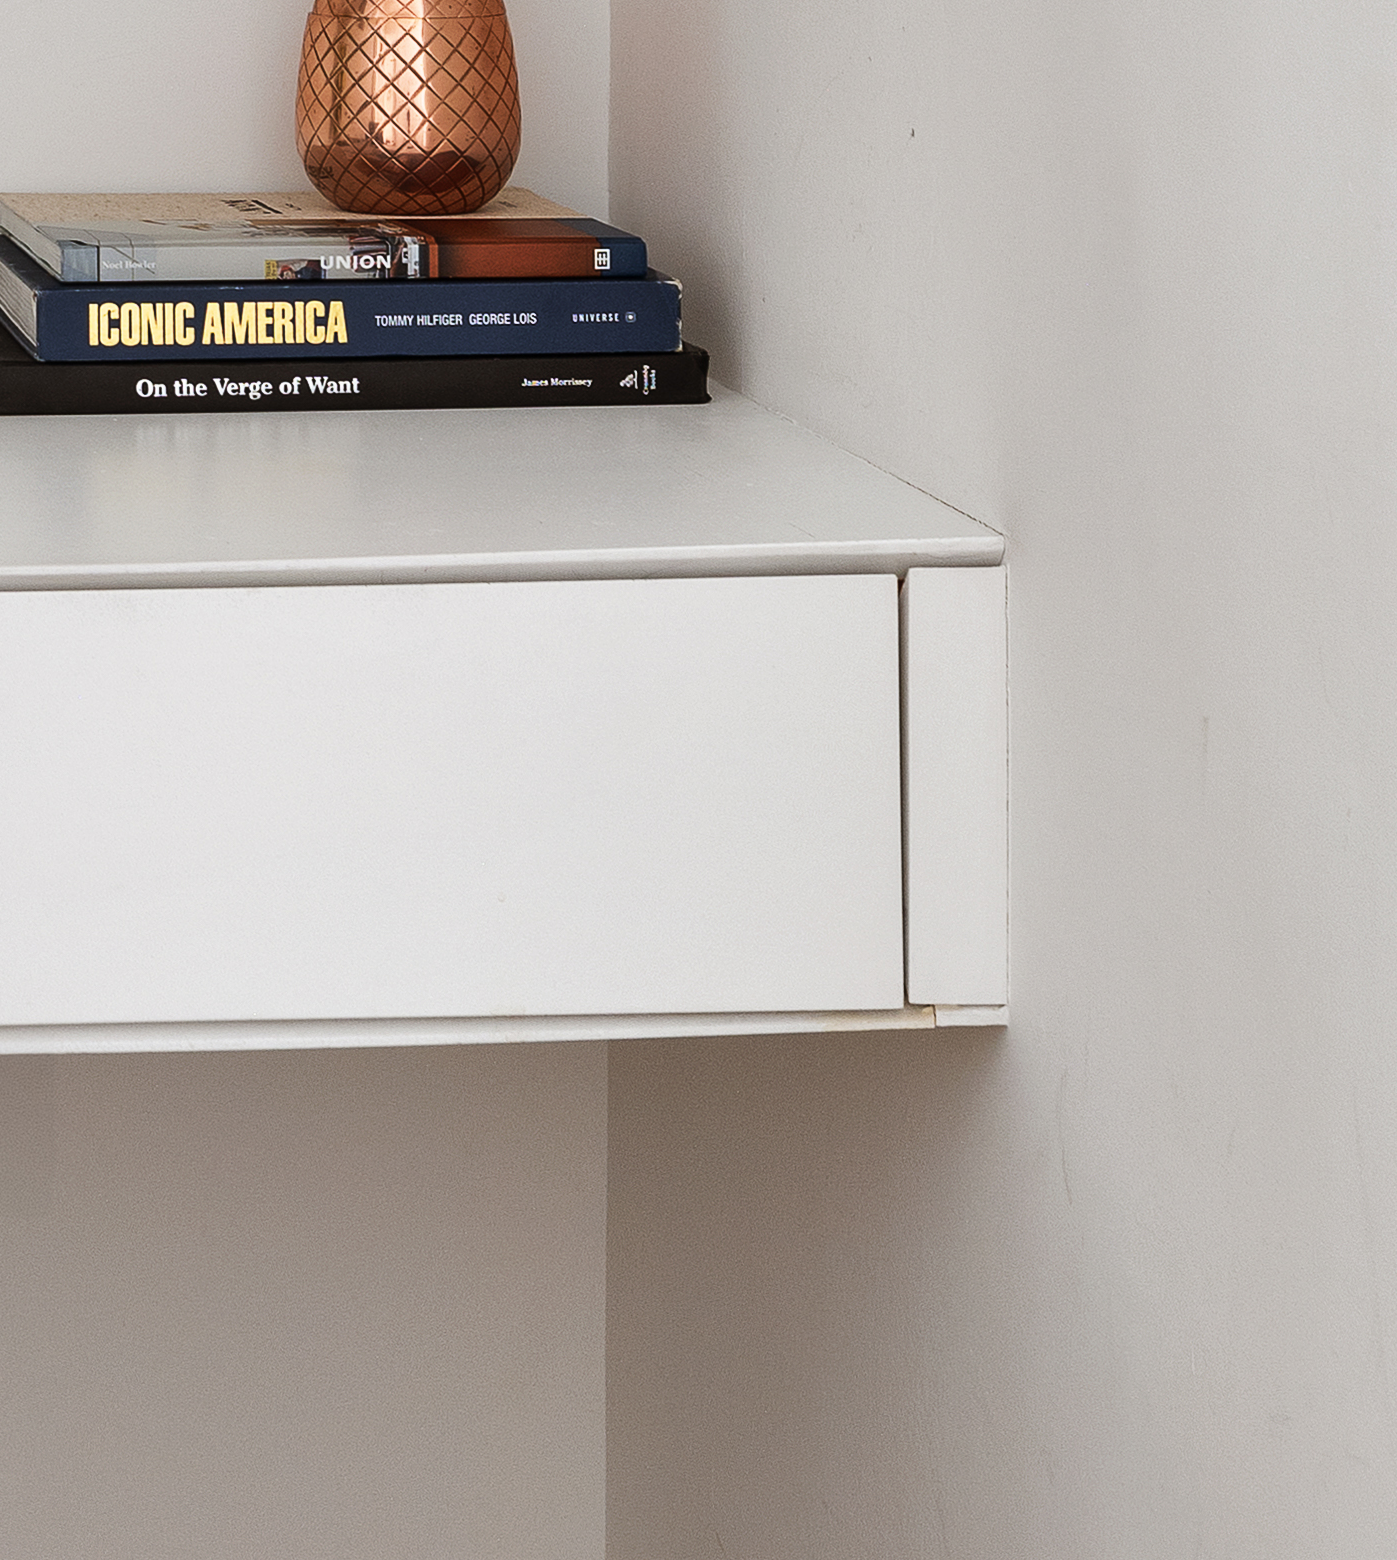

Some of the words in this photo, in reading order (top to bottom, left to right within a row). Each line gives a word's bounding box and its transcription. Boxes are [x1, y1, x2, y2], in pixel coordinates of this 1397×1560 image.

[320, 254, 392, 270] UNION
[89, 302, 195, 348] ICONIC
[202, 300, 347, 345] AMERICA
[375, 314, 413, 327] TOMMY
[416, 314, 462, 326] HILFIGER
[469, 313, 507, 326] GEORGE
[511, 312, 536, 325] LOIS
[572, 313, 619, 322] UNIVERSE
[136, 379, 167, 399] On
[174, 378, 207, 398] the
[213, 377, 272, 400] Verge
[279, 377, 299, 396] of
[305, 376, 359, 396] Want
[522, 377, 549, 388] James
[553, 377, 593, 390] Morrissey
